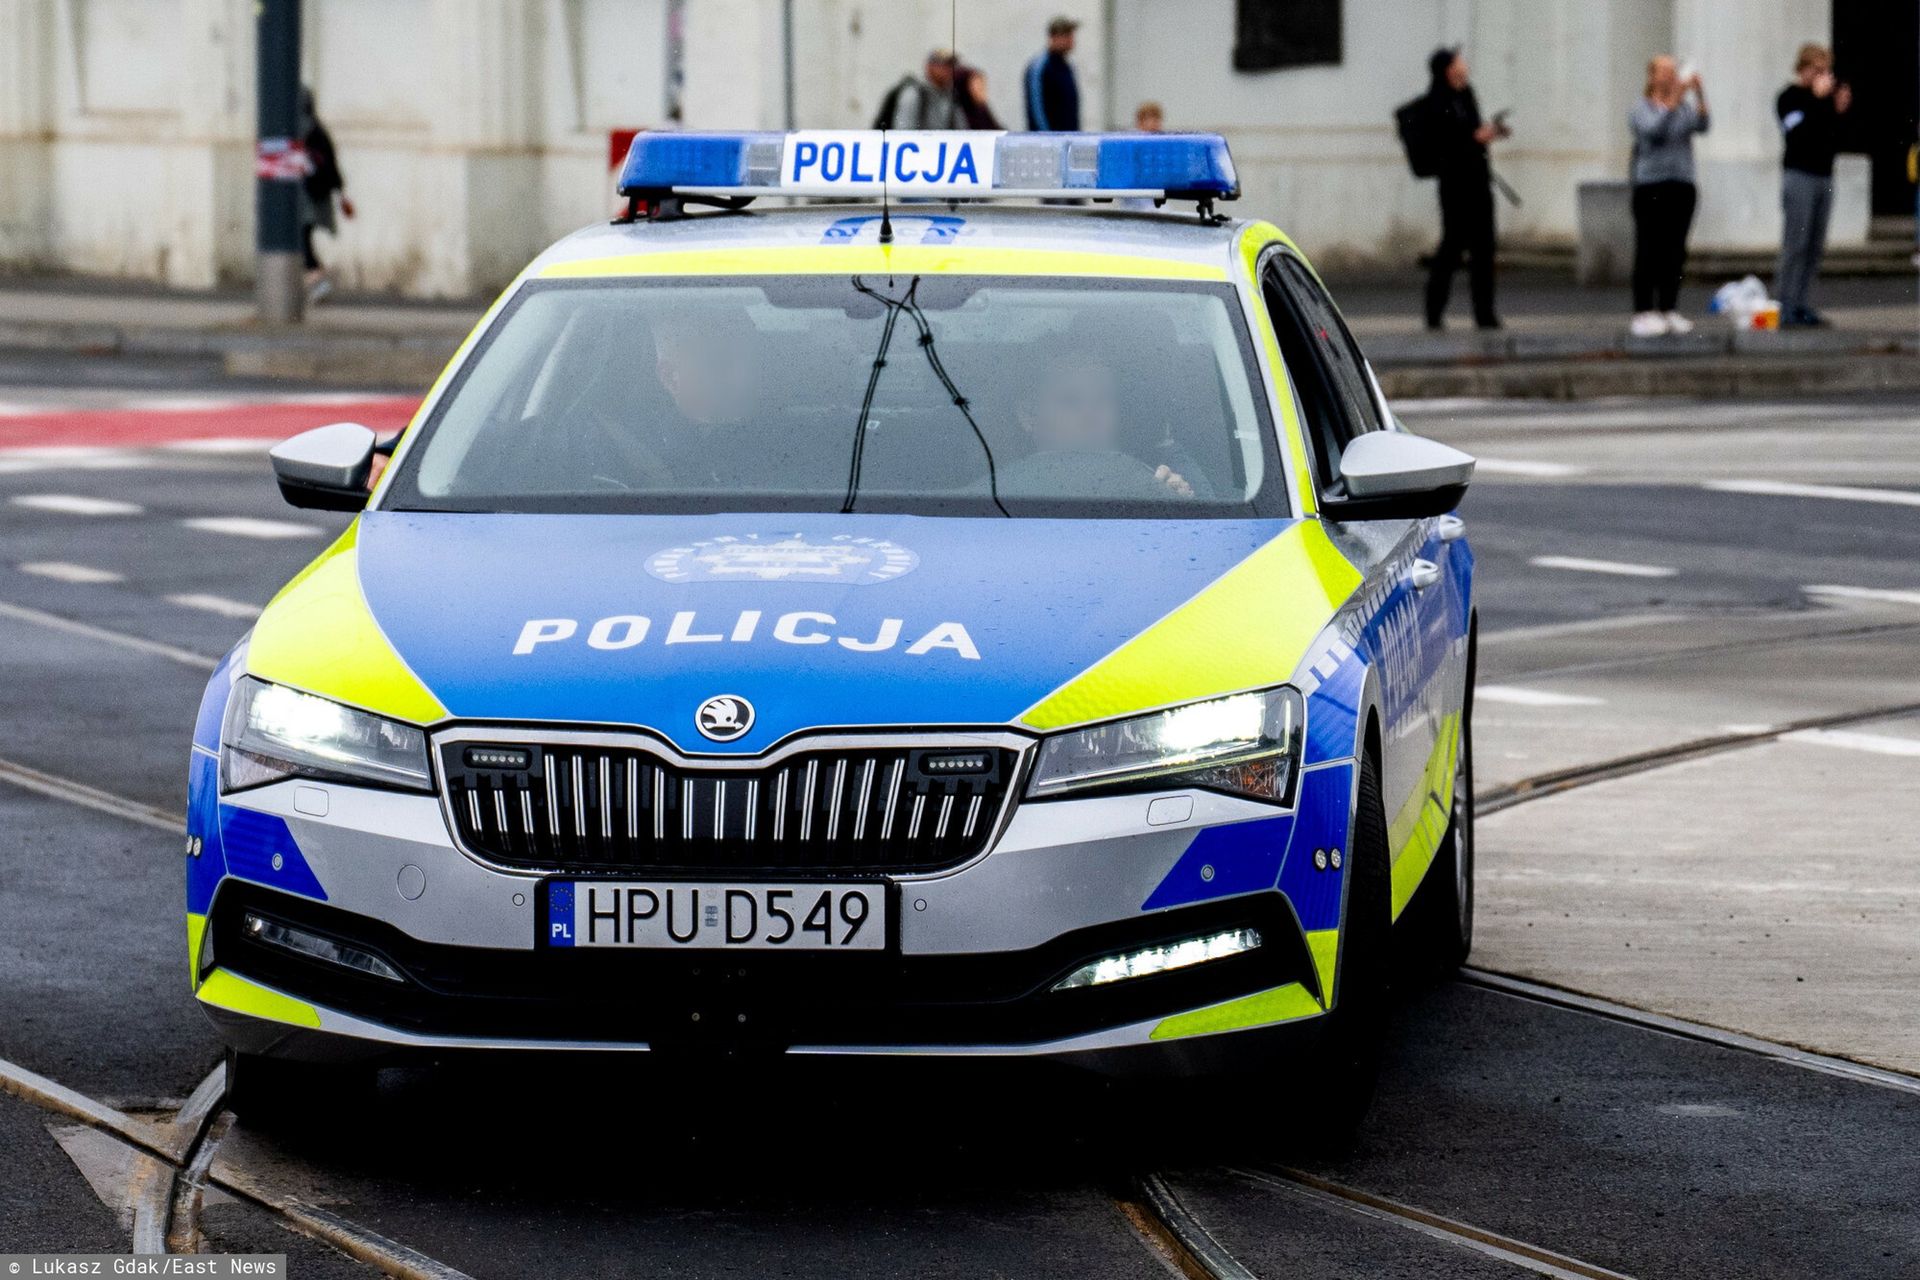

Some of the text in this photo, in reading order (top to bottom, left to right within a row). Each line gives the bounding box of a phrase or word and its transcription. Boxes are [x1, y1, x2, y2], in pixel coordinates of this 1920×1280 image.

[792, 140, 979, 184] POLICJA
[512, 610, 981, 660] POLICJA
[552, 923, 571, 938] PL
[588, 888, 869, 945] HPU D549
